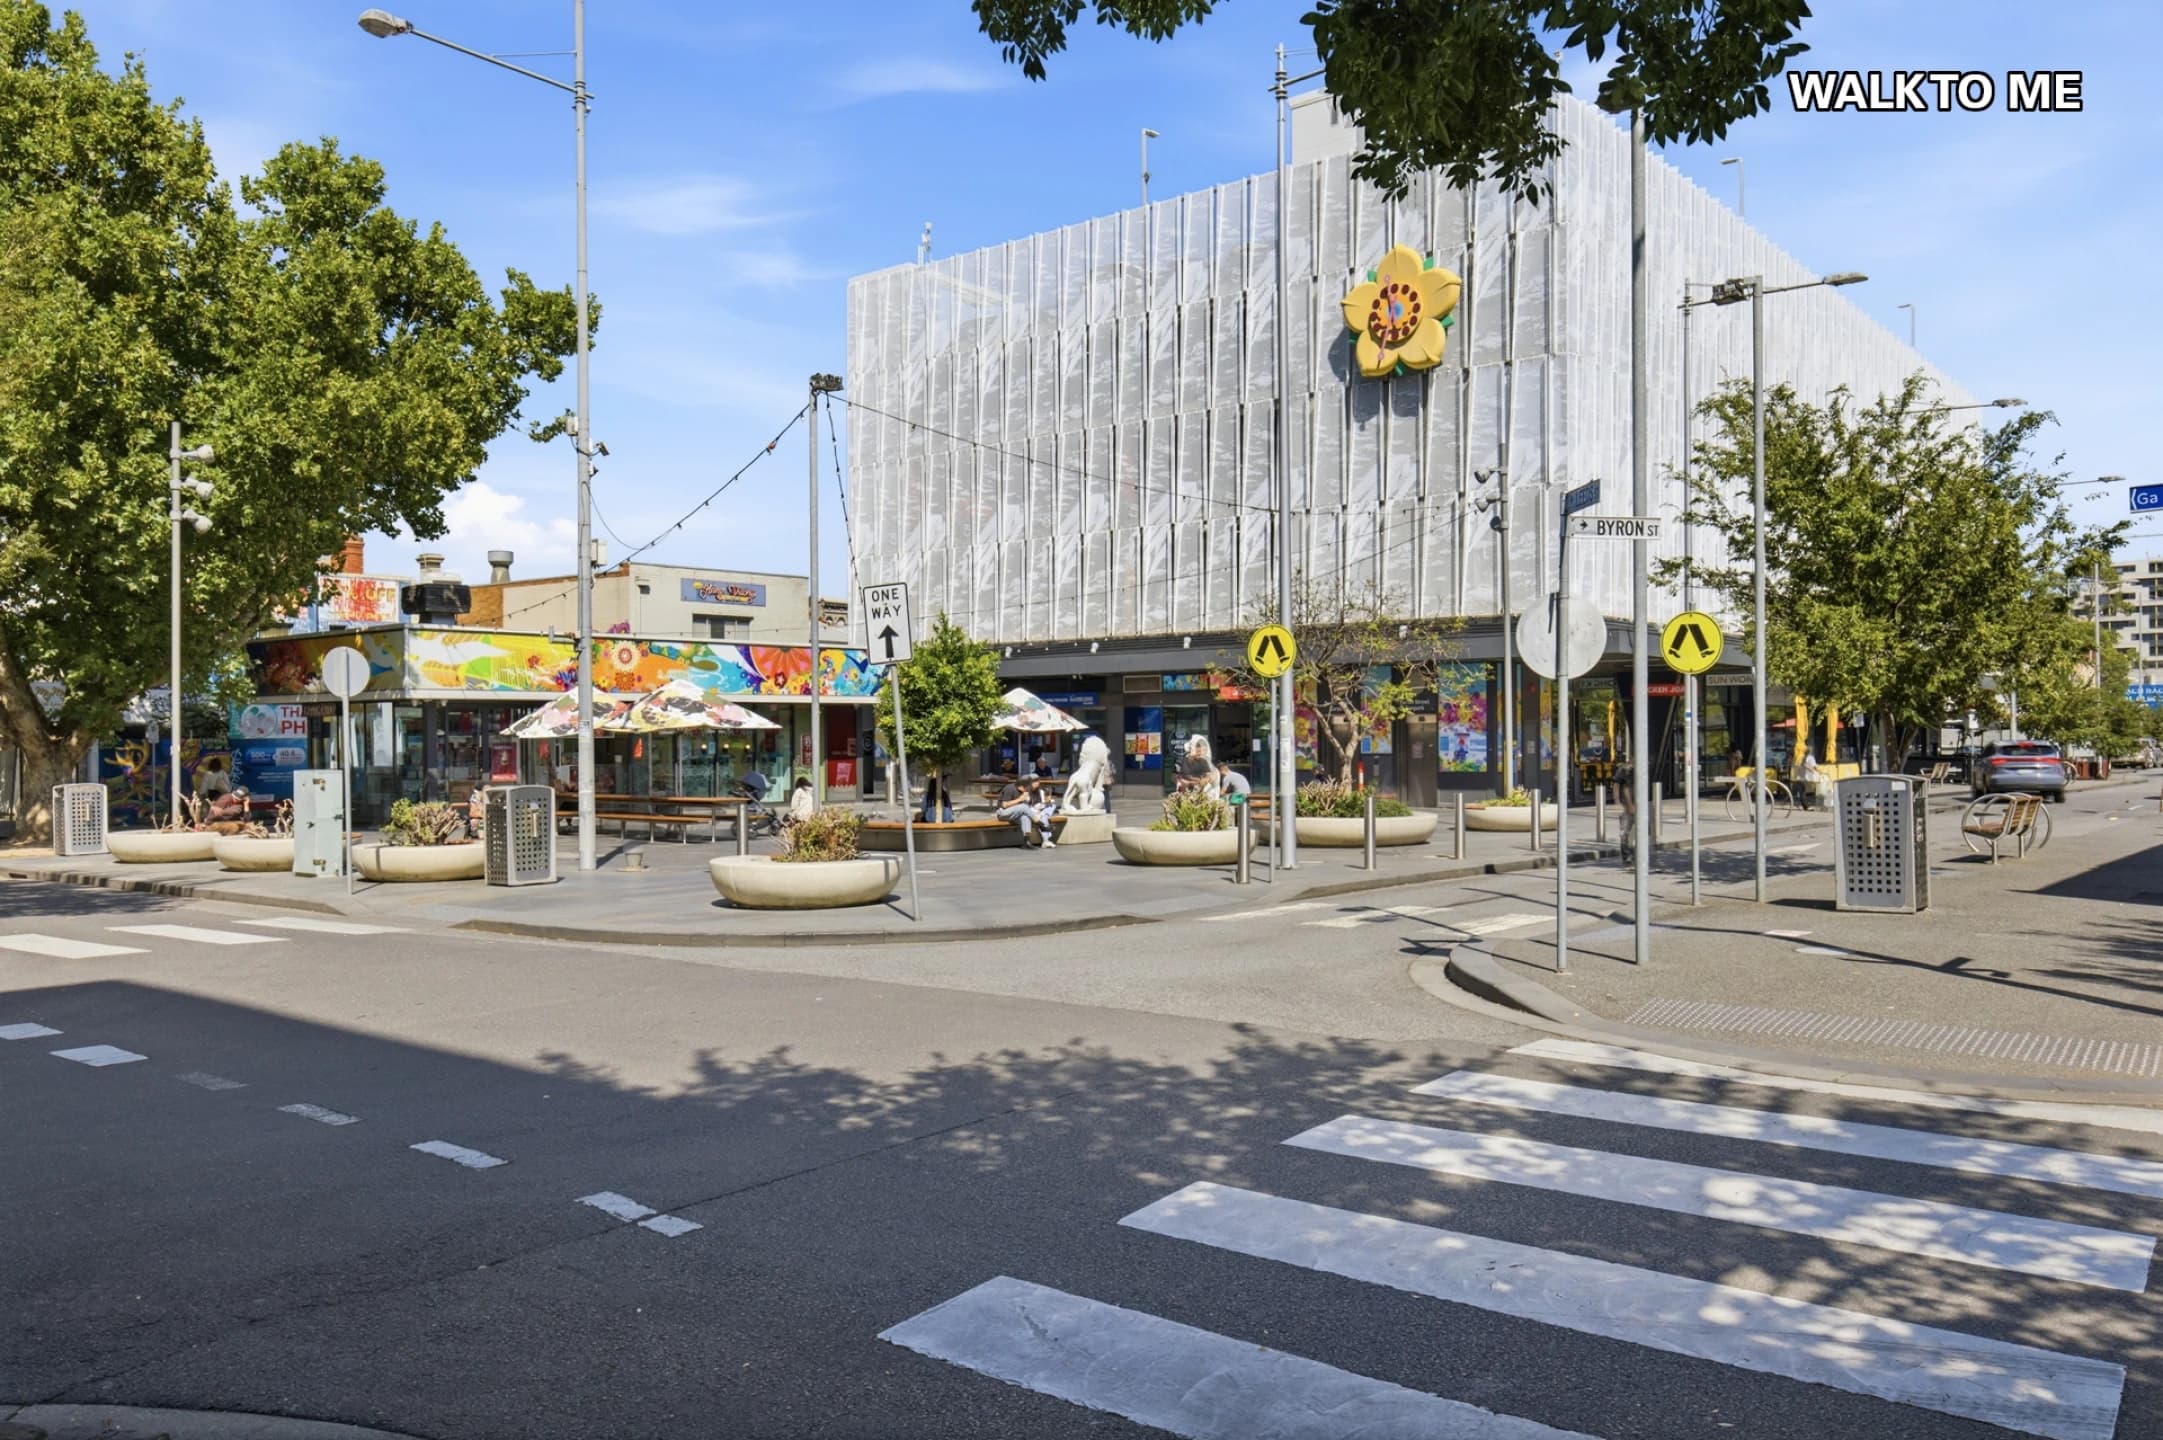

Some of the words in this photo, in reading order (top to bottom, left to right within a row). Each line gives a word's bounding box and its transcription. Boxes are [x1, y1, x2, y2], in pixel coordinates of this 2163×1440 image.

[1597, 520, 1645, 536] BYRON
[1647, 525, 1659, 536] ST
[871, 588, 900, 602] ONE
[872, 604, 902, 620] WAY
[1727, 673, 1754, 685] WON
